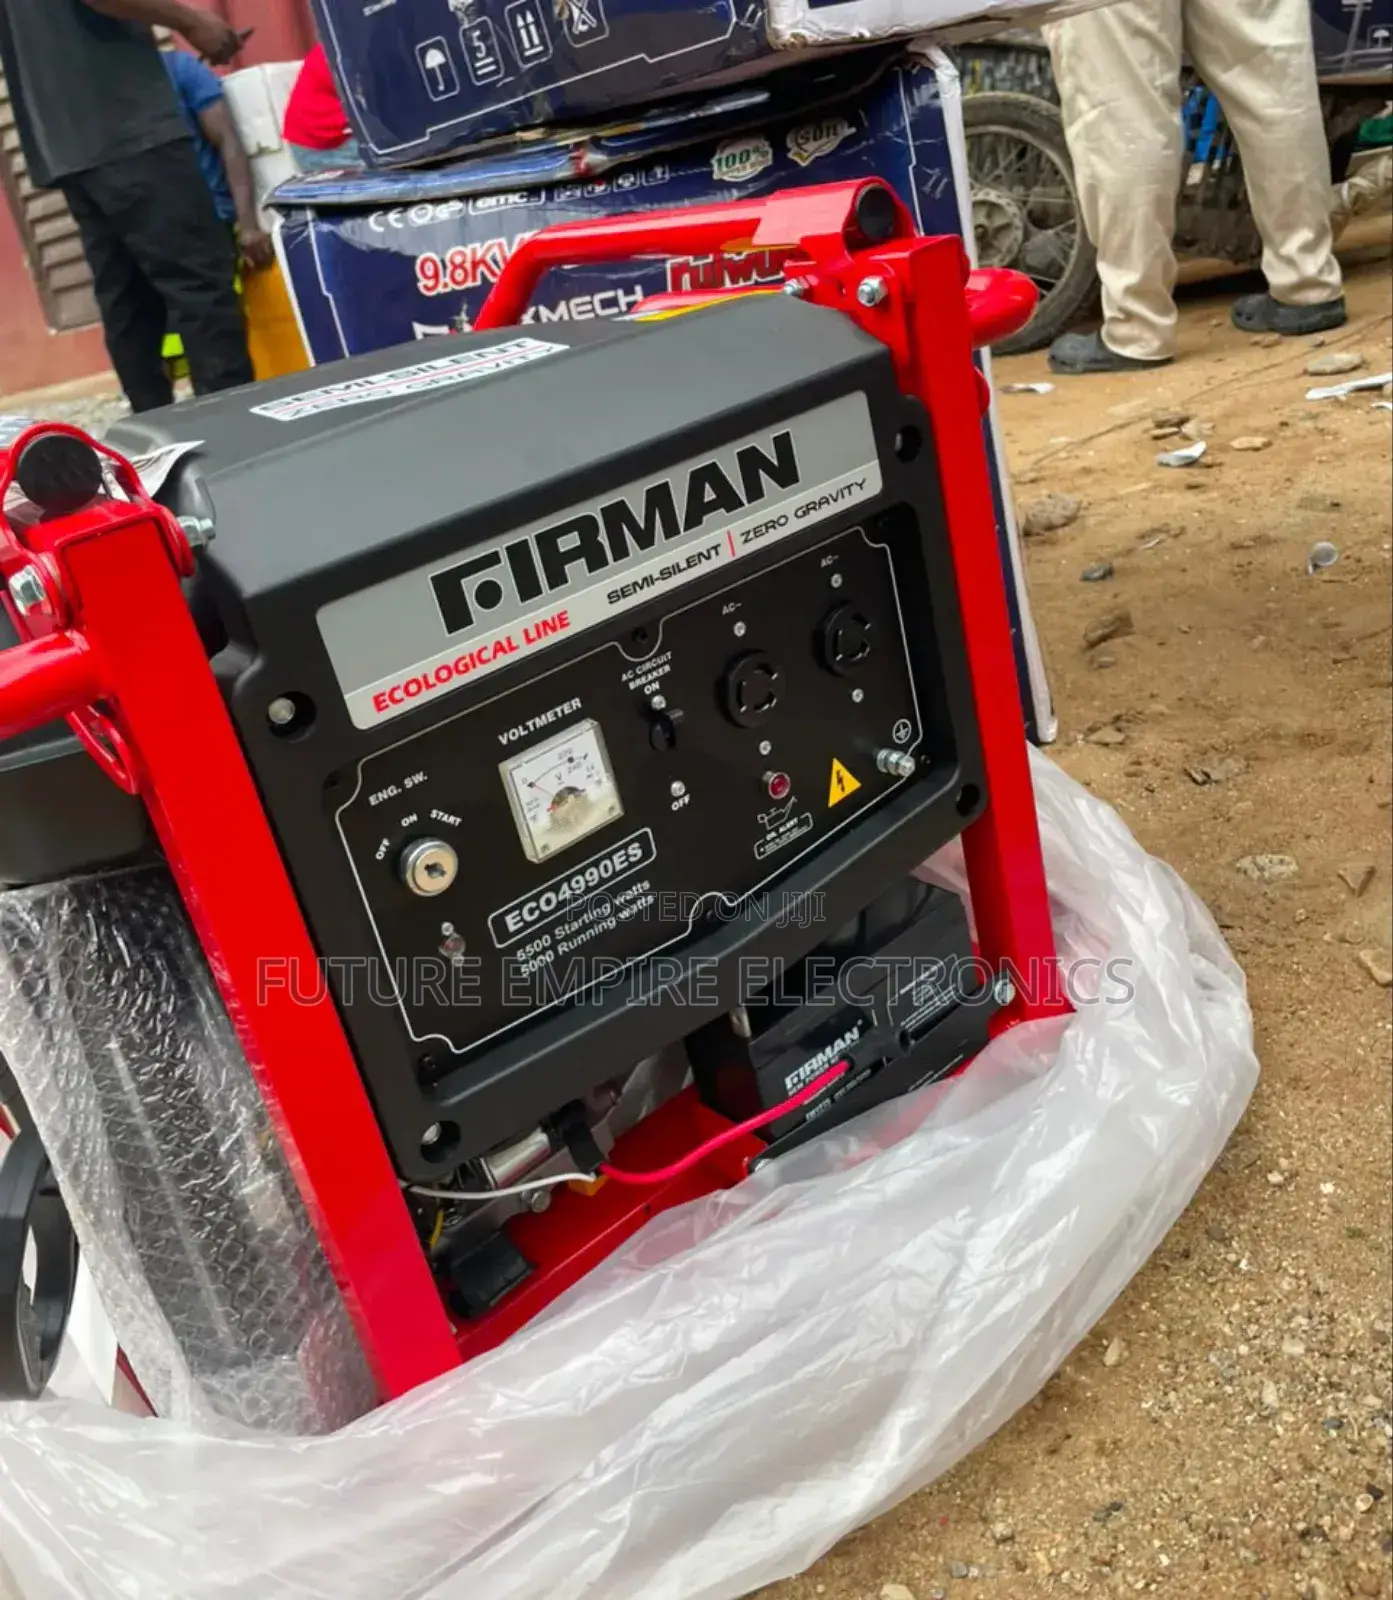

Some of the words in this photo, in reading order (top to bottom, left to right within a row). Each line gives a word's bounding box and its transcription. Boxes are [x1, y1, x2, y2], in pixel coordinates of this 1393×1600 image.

[427, 429, 801, 637] FIRMAN
[607, 543, 722, 605] SEMI-SILENT
[740, 516, 789, 544] ZERO
[794, 478, 867, 519] GRAVITY
[372, 635, 520, 714] ECOLOGICAL
[522, 610, 572, 646] LINE
[621, 669, 635, 682] AC
[636, 650, 672, 675] CIRCUIT
[629, 664, 671, 690] BREAKER
[643, 681, 660, 695] ON
[497, 697, 583, 746] VOLTMETER
[368, 784, 402, 807] ENG.
[404, 771, 428, 789] SW.
[671, 794, 690, 811] OFF
[401, 813, 418, 827] ON
[430, 809, 462, 827] START
[375, 838, 390, 860] OFF
[504, 842, 643, 933] ECO4990ES
[516, 935, 551, 962] 5500
[554, 902, 611, 940] Starting
[520, 951, 555, 977] 5000
[557, 916, 617, 955] Running
[617, 896, 654, 920] watts
[785, 1026, 860, 1091] FIRMAN
